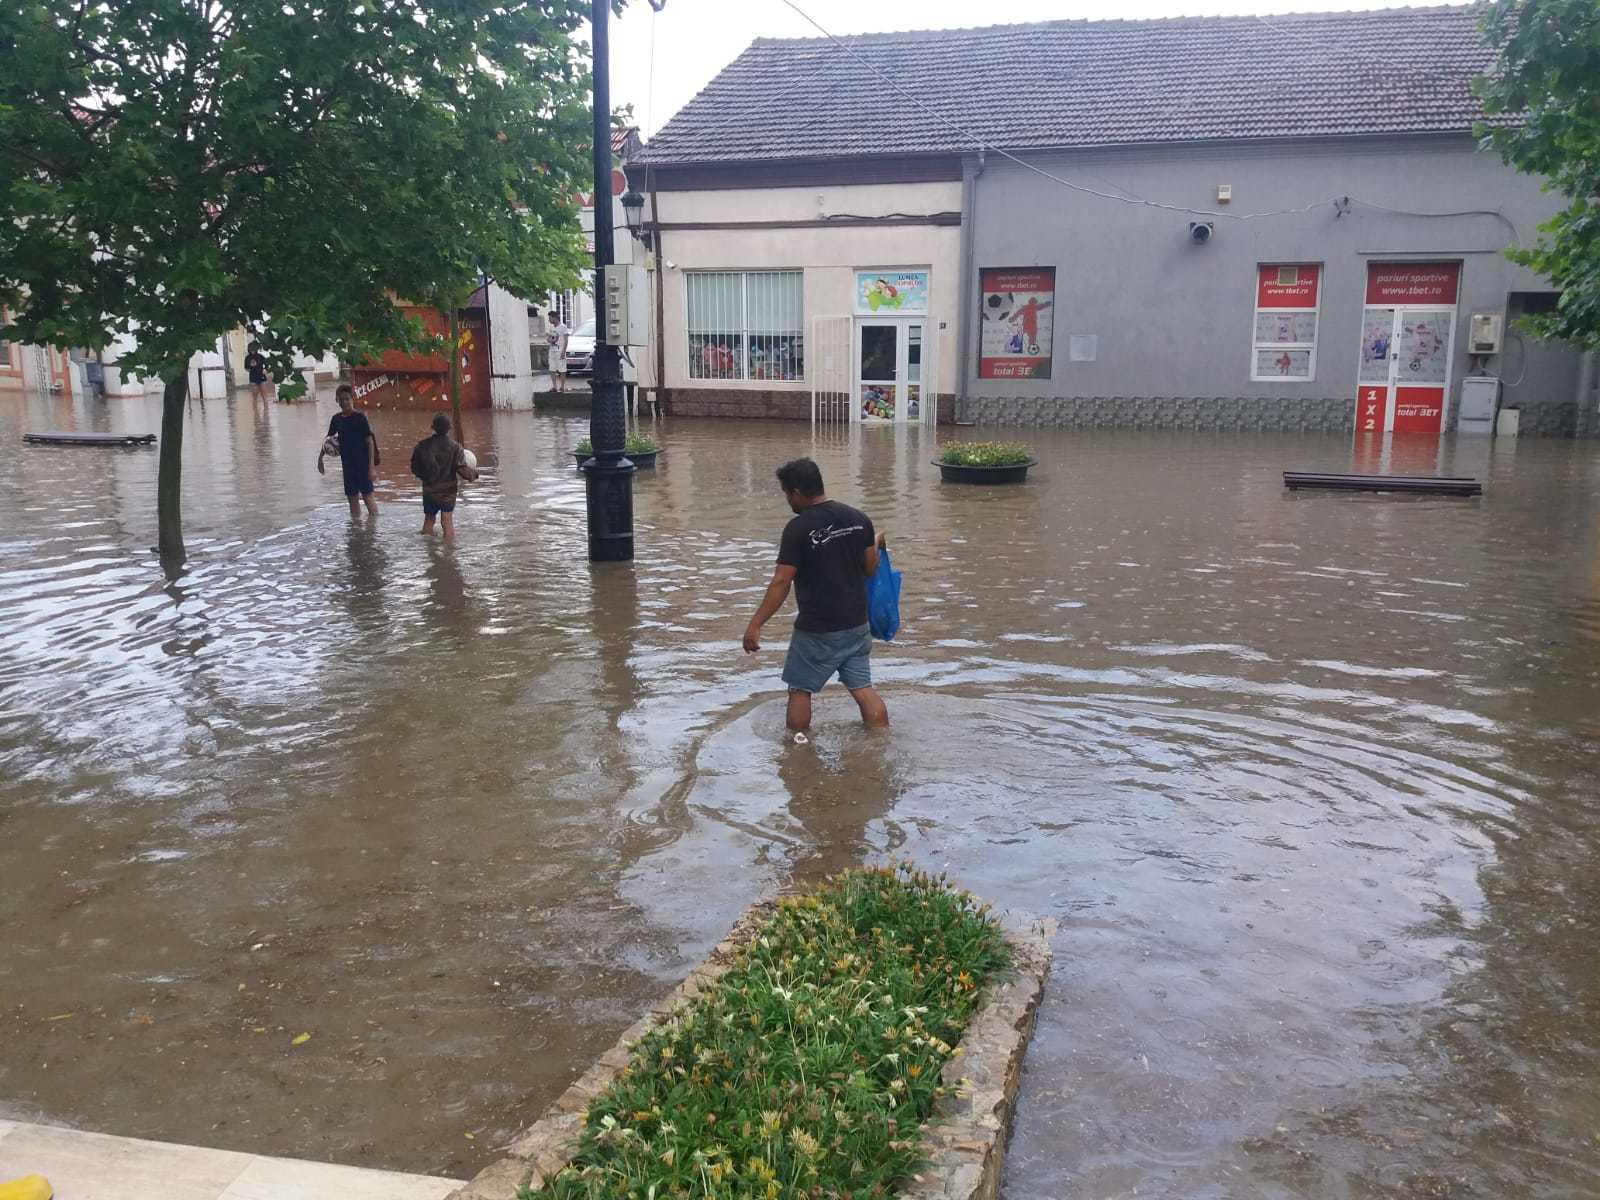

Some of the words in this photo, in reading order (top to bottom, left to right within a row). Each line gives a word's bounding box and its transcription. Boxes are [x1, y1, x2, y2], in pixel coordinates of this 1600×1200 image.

[1410, 272, 1449, 284] sportive
[1381, 286, 1442, 296] www.tbet.ro
[1397, 408, 1417, 417] total
